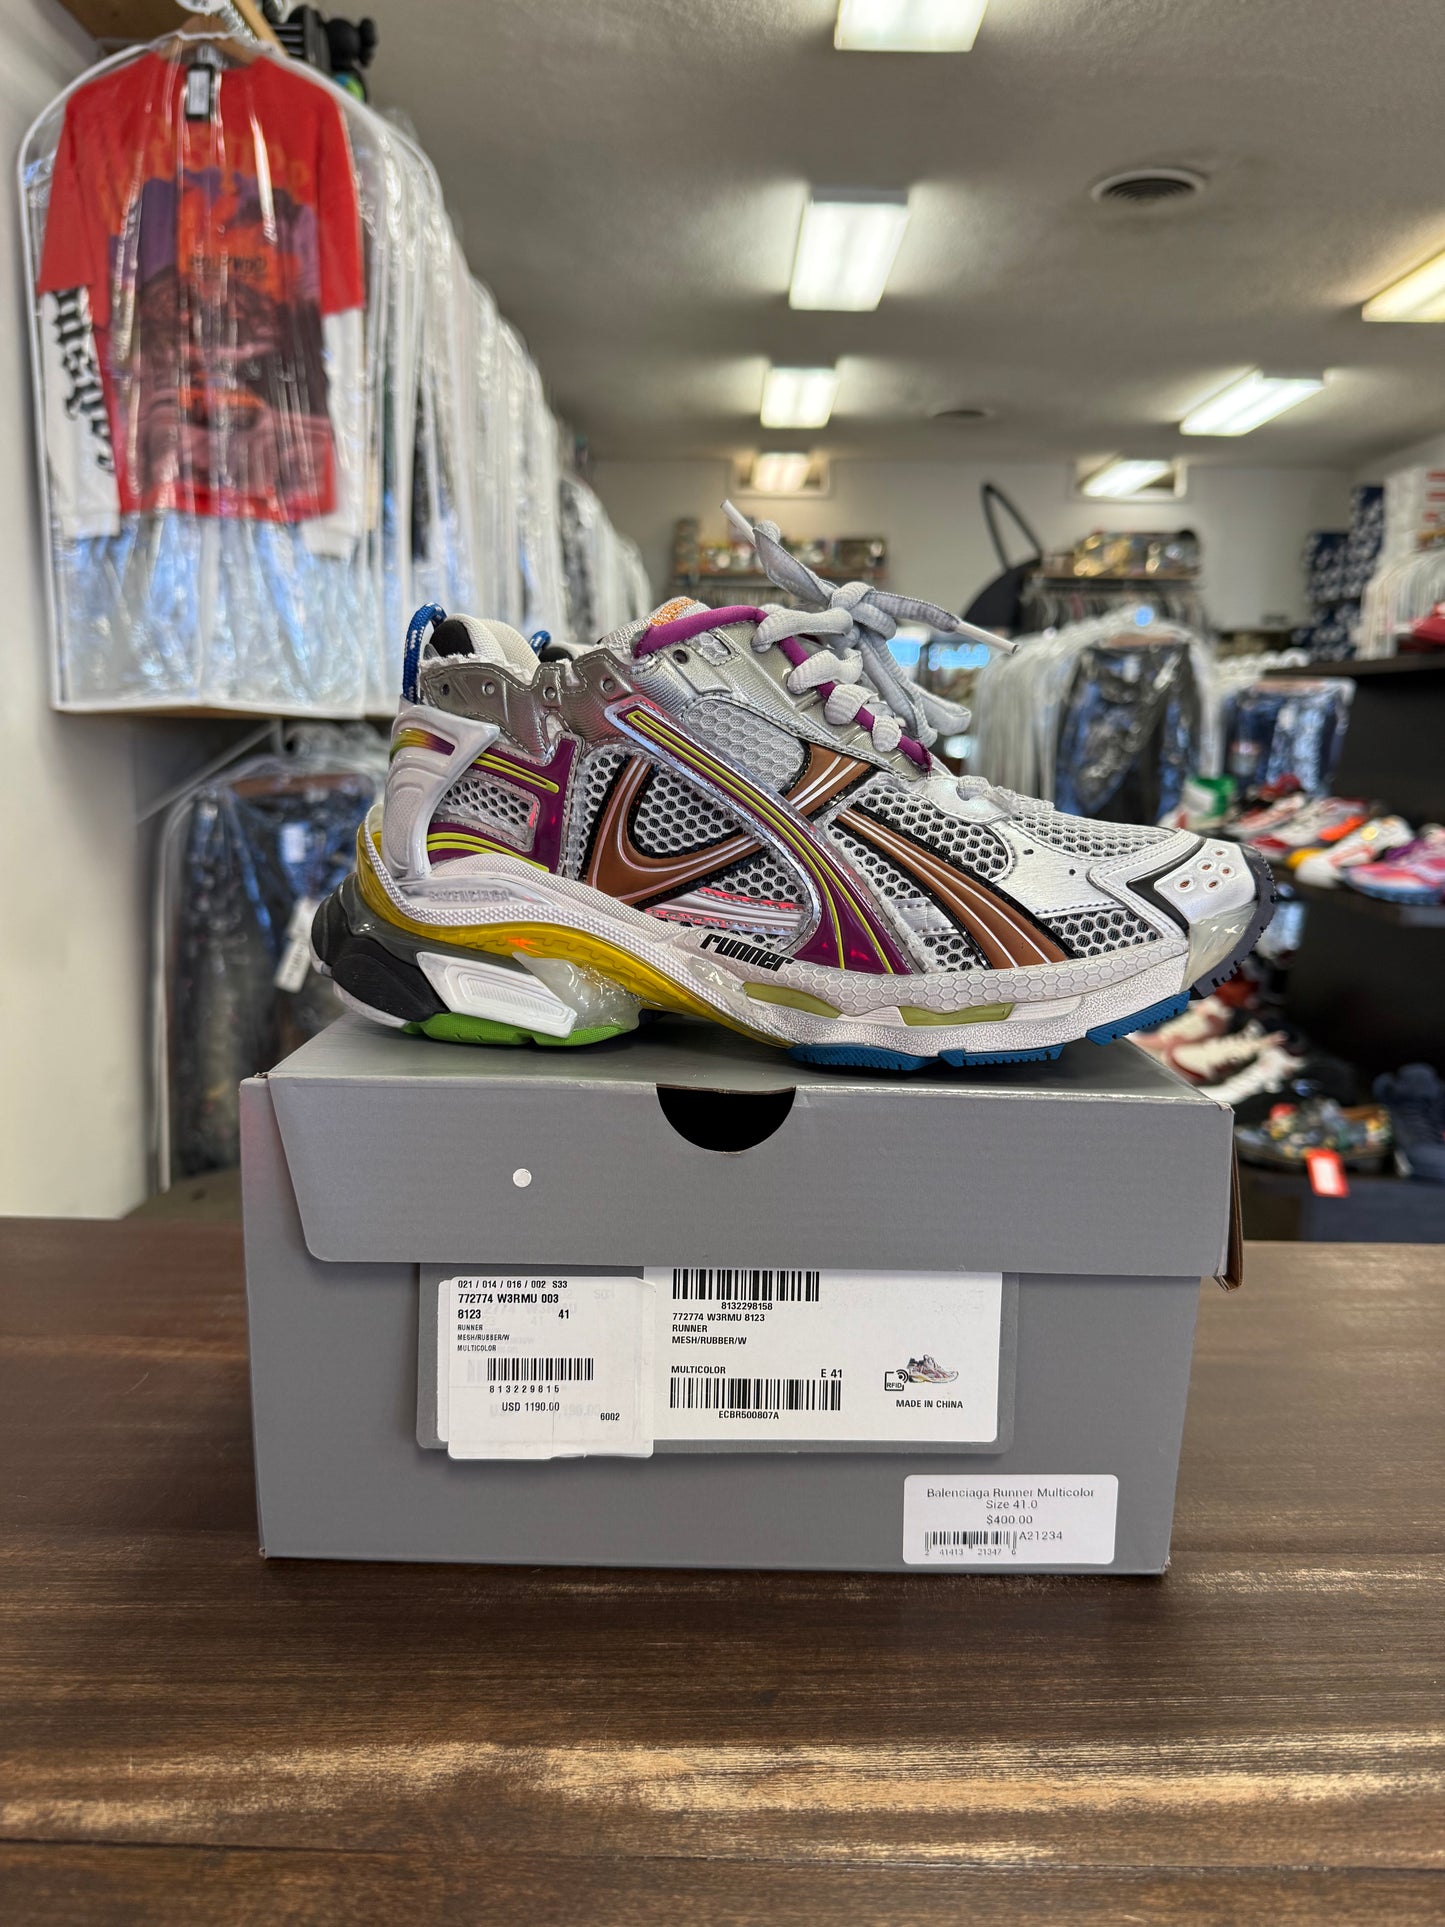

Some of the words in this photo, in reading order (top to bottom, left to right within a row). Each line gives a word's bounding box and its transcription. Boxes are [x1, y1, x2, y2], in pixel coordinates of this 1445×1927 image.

[699, 933, 795, 972] runner
[457, 1280, 473, 1289] 021
[482, 1280, 497, 1289] 014
[506, 1280, 522, 1289] 016
[531, 1280, 546, 1289] 002
[552, 1280, 568, 1289] S33
[458, 1293, 494, 1304] 772774
[497, 1293, 538, 1304] W3RMU
[541, 1293, 560, 1304] 003
[721, 1301, 773, 1311] 8132298158
[457, 1309, 482, 1320] 8123
[558, 1309, 570, 1320] 41
[672, 1312, 704, 1321] 772774
[707, 1313, 742, 1321] W3RMU
[744, 1313, 766, 1322] 8123
[672, 1324, 708, 1333] RUNNER
[671, 1336, 747, 1345] MESH/RUBBER/W
[671, 1365, 726, 1374] MULTICOLOR
[820, 1368, 827, 1378] E
[830, 1368, 843, 1378] 41
[501, 1402, 521, 1412] USD
[524, 1402, 560, 1412] 1190.00
[896, 1399, 922, 1408] MADE
[924, 1399, 933, 1408] IN
[936, 1400, 964, 1409] CHINA
[600, 1412, 621, 1421] 6002
[718, 1411, 780, 1420] ECBR500807A
[927, 1488, 990, 1500] Balenciaga
[993, 1488, 1034, 1498] Runner
[1037, 1488, 1095, 1498] Multicolor
[986, 1500, 1010, 1509] Size
[1013, 1500, 1038, 1509] 41.0
[986, 1515, 1034, 1525] $400.00
[1019, 1531, 1063, 1540] A21234
